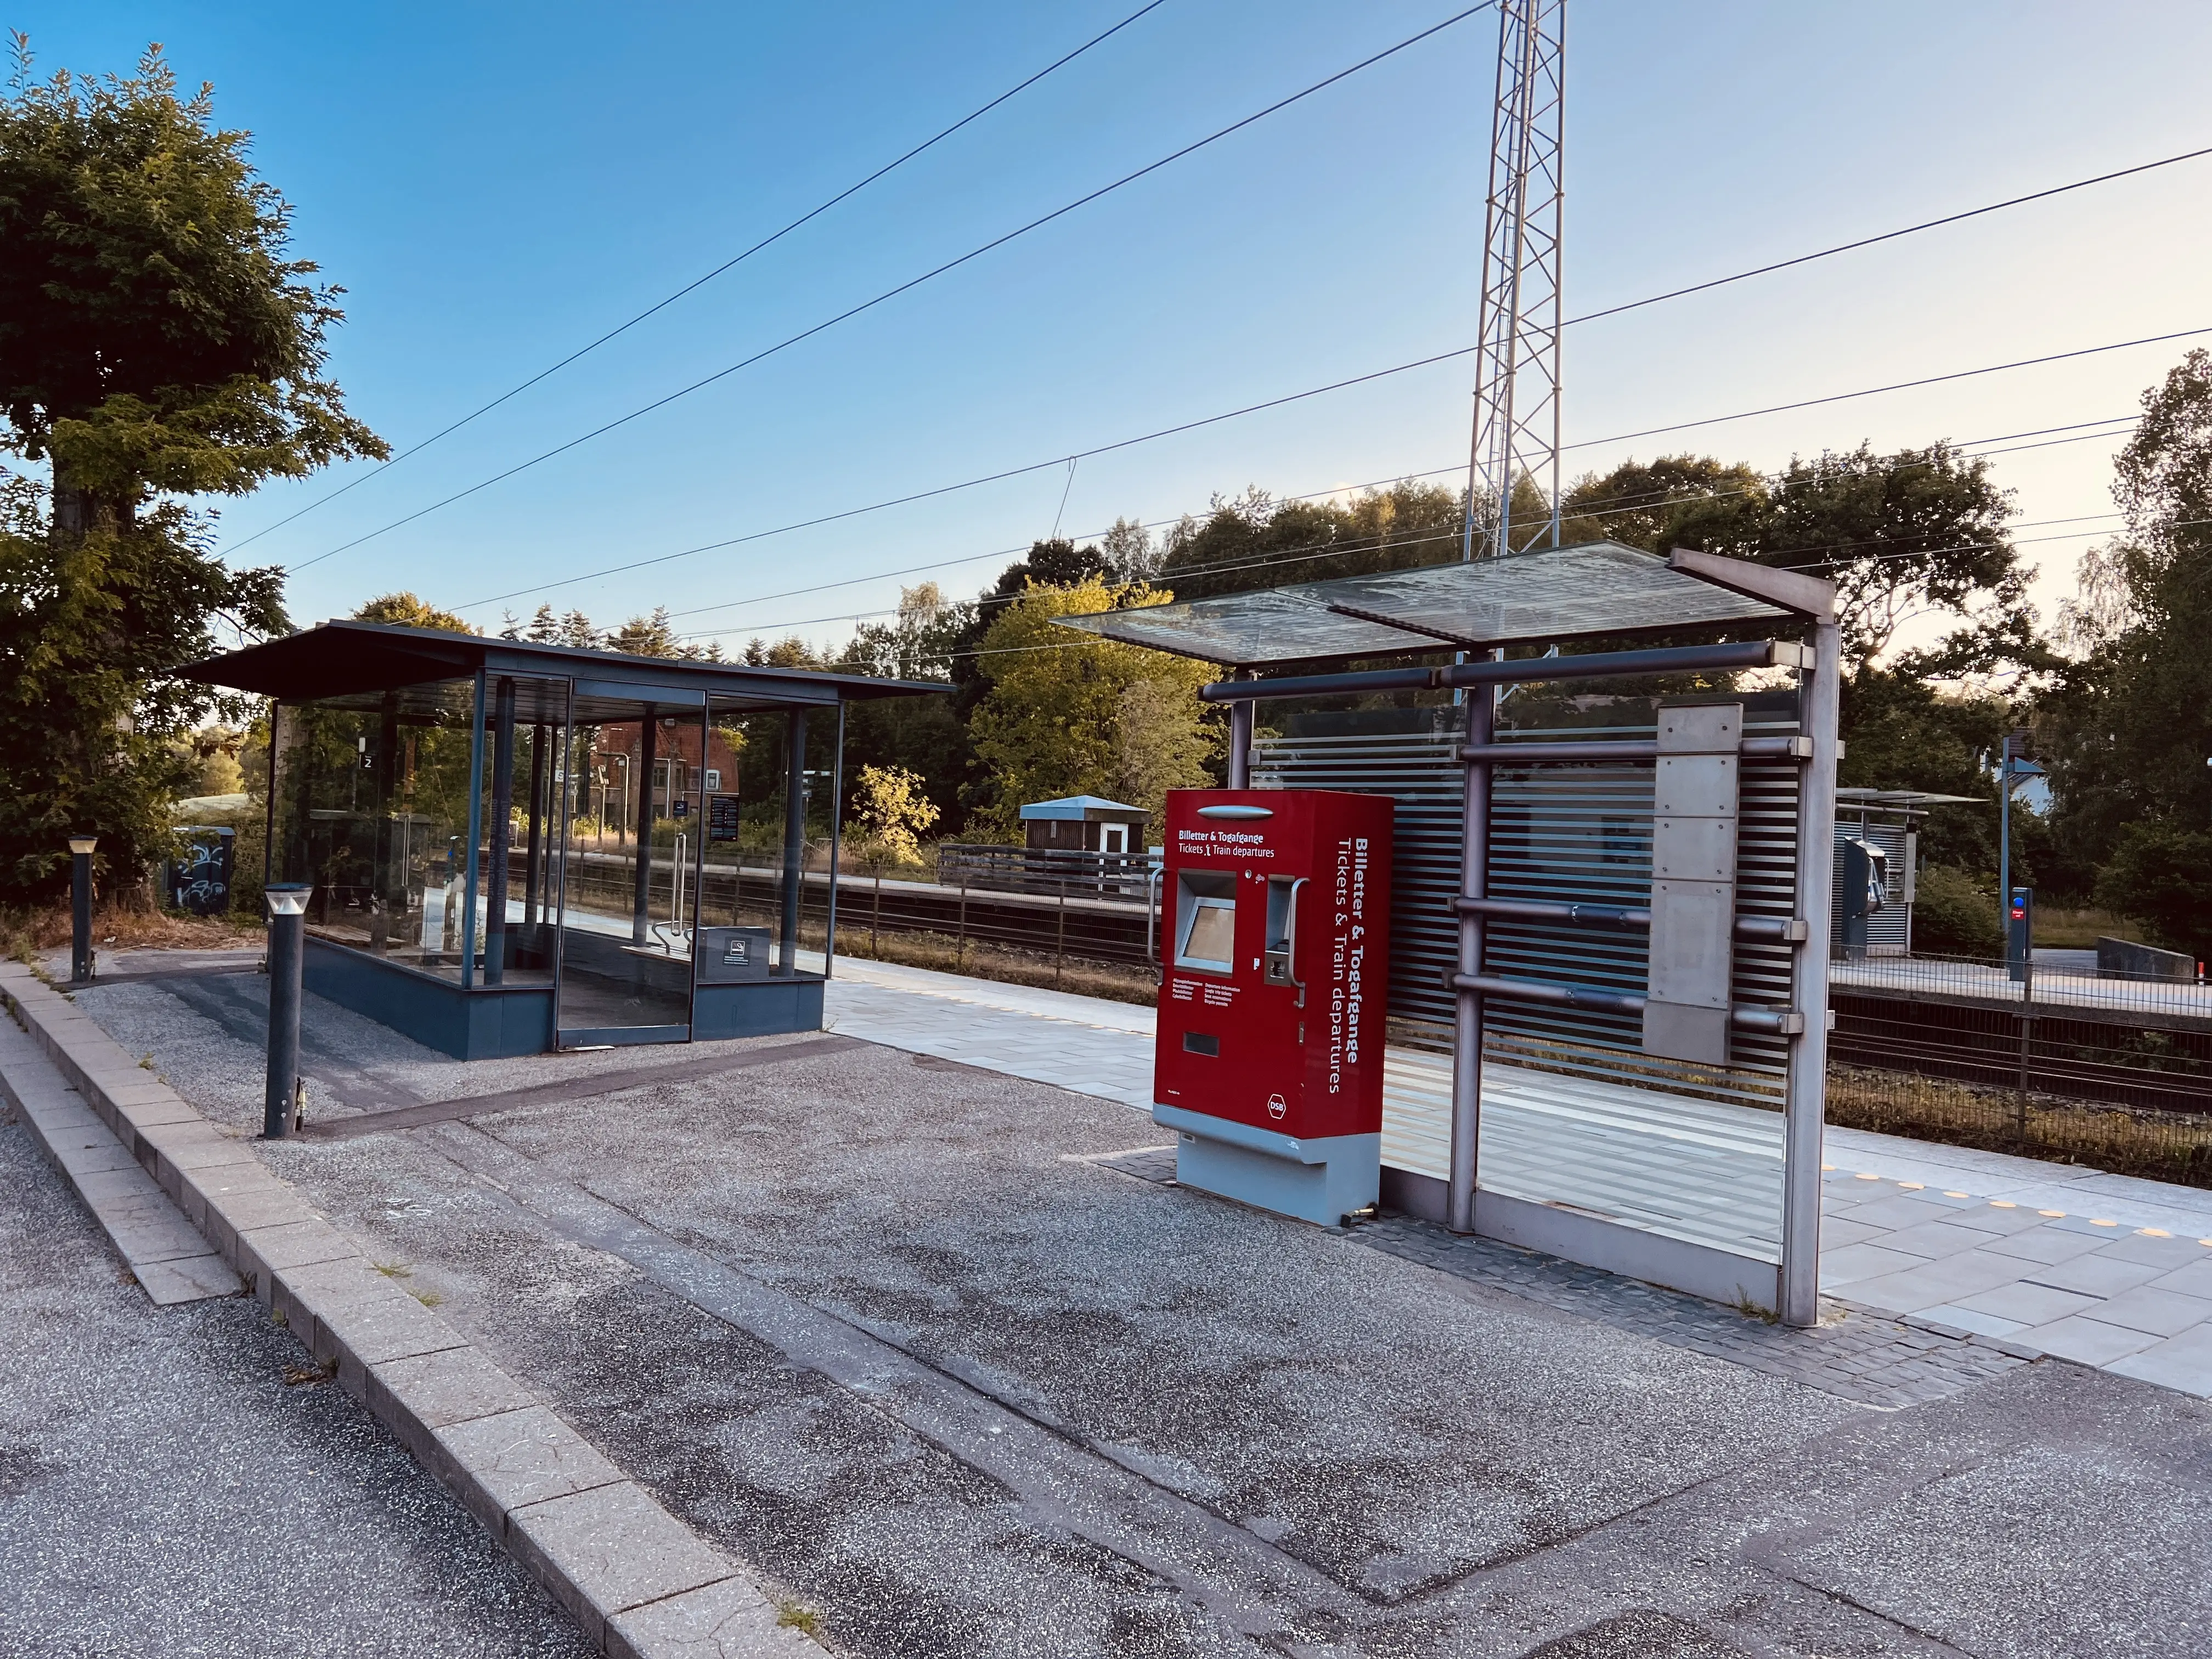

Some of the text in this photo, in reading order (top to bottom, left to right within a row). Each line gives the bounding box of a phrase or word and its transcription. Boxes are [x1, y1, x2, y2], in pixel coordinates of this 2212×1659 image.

[1179, 830, 1263, 845] Billetter & Togafgange
[1179, 843, 1203, 854] Tickets
[1213, 845, 1231, 855] Train
[1233, 845, 1274, 857] departures
[1346, 838, 1368, 1063] Billetter & Togafgange
[1329, 837, 1351, 1094] Tickets & Train departures
[1270, 1102, 1284, 1111] DSB
